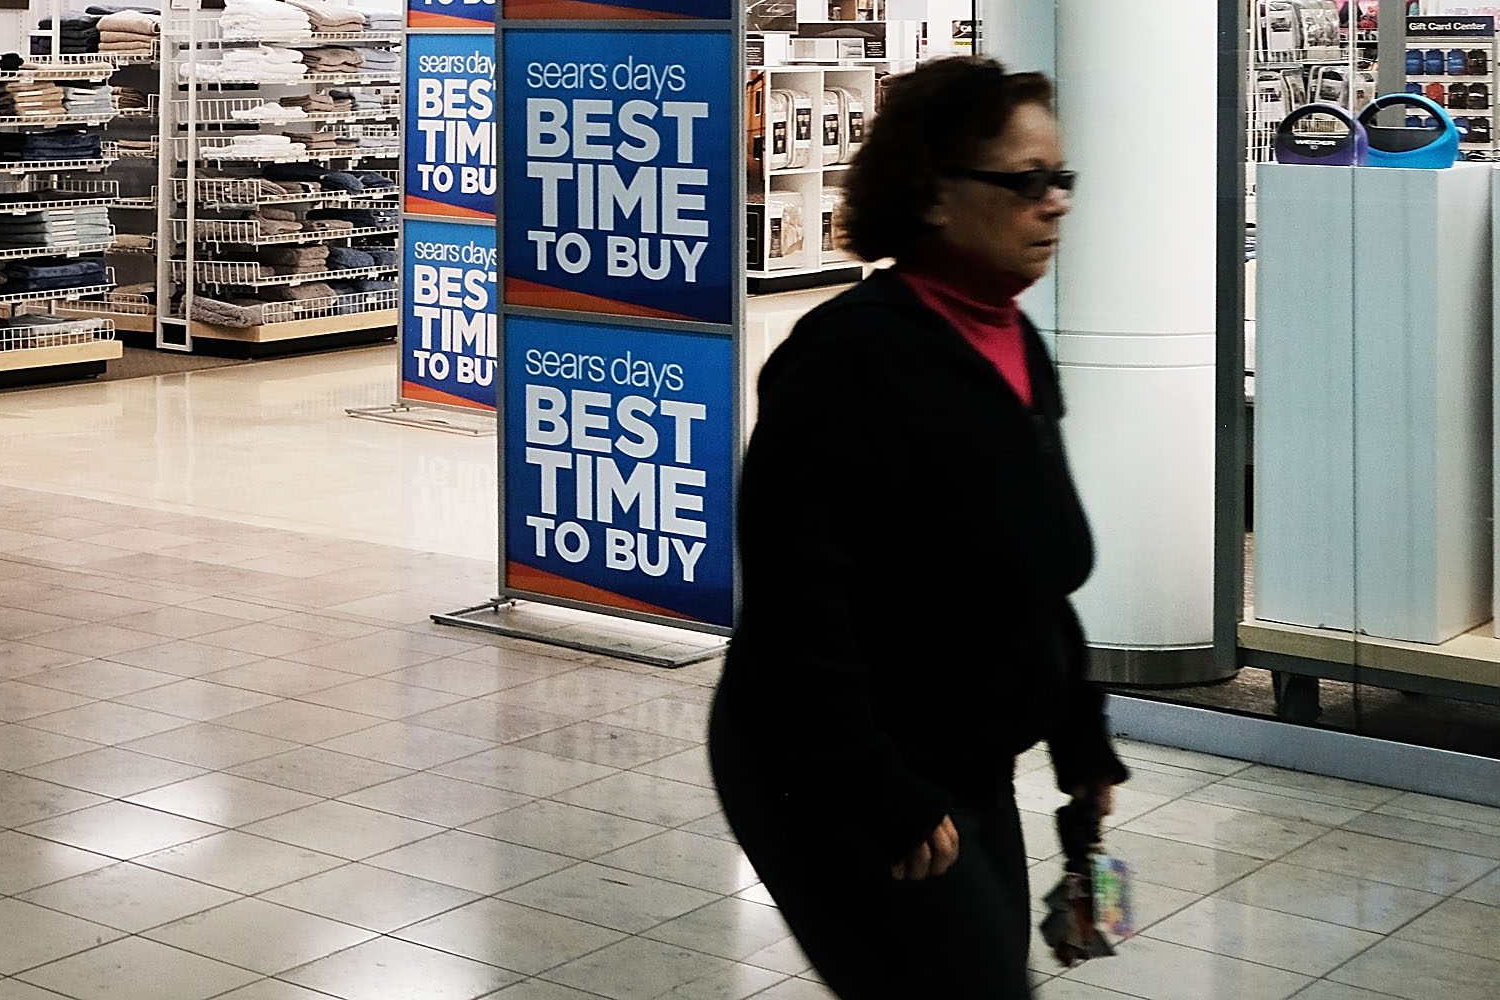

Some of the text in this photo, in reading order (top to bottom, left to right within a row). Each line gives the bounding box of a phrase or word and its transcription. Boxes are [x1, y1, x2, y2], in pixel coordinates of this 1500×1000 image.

[1408, 22, 1487, 31] Gift Card Center
[419, 51, 496, 79] sears day
[526, 56, 686, 100] sears days
[418, 78, 496, 119] BES
[418, 119, 496, 166] TIM
[526, 98, 708, 163] BEST
[417, 164, 496, 195] TO BU
[526, 162, 708, 237] TIME
[414, 241, 460, 262] sears
[527, 230, 708, 283] TO BUY
[413, 350, 497, 386] TO BU
[525, 347, 684, 398] sears days
[525, 384, 707, 464] BEST
[525, 447, 707, 539] TIME
[526, 516, 707, 583] TO BUY
